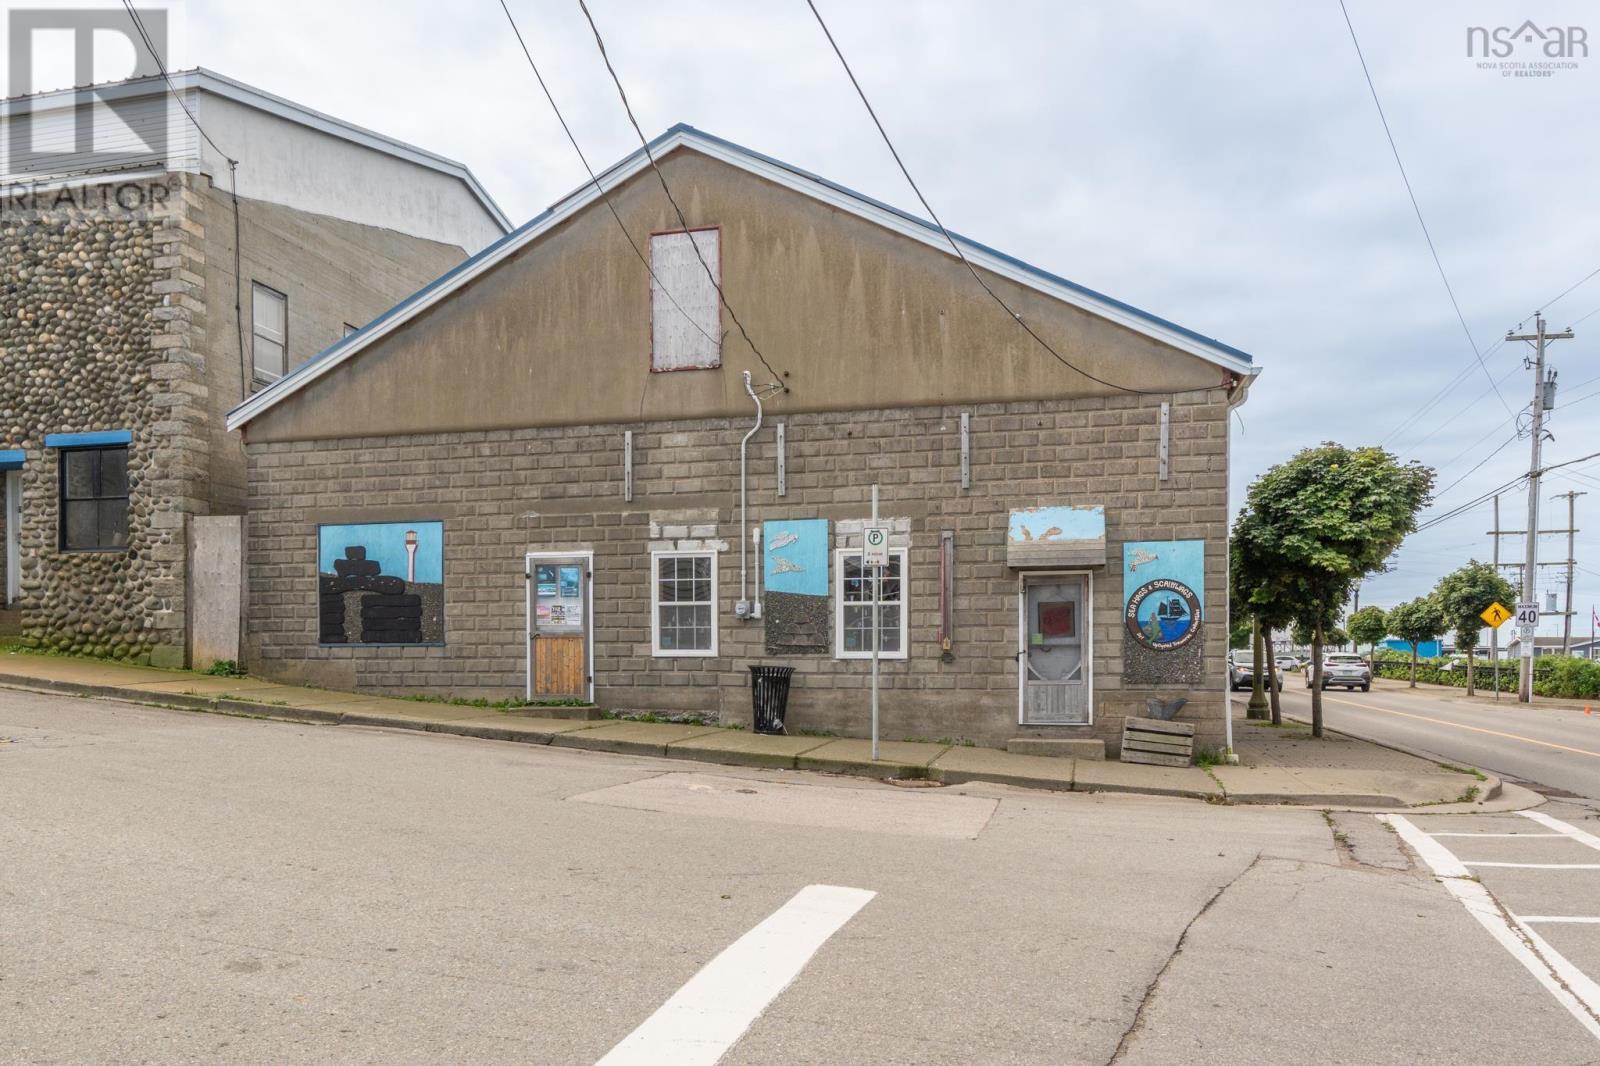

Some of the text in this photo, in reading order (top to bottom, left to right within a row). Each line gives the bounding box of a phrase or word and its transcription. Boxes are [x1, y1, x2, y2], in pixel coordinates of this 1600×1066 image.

[1128, 605, 1136, 618] SEA
[1132, 587, 1148, 604] HAGS
[1518, 610, 1536, 623] 40
